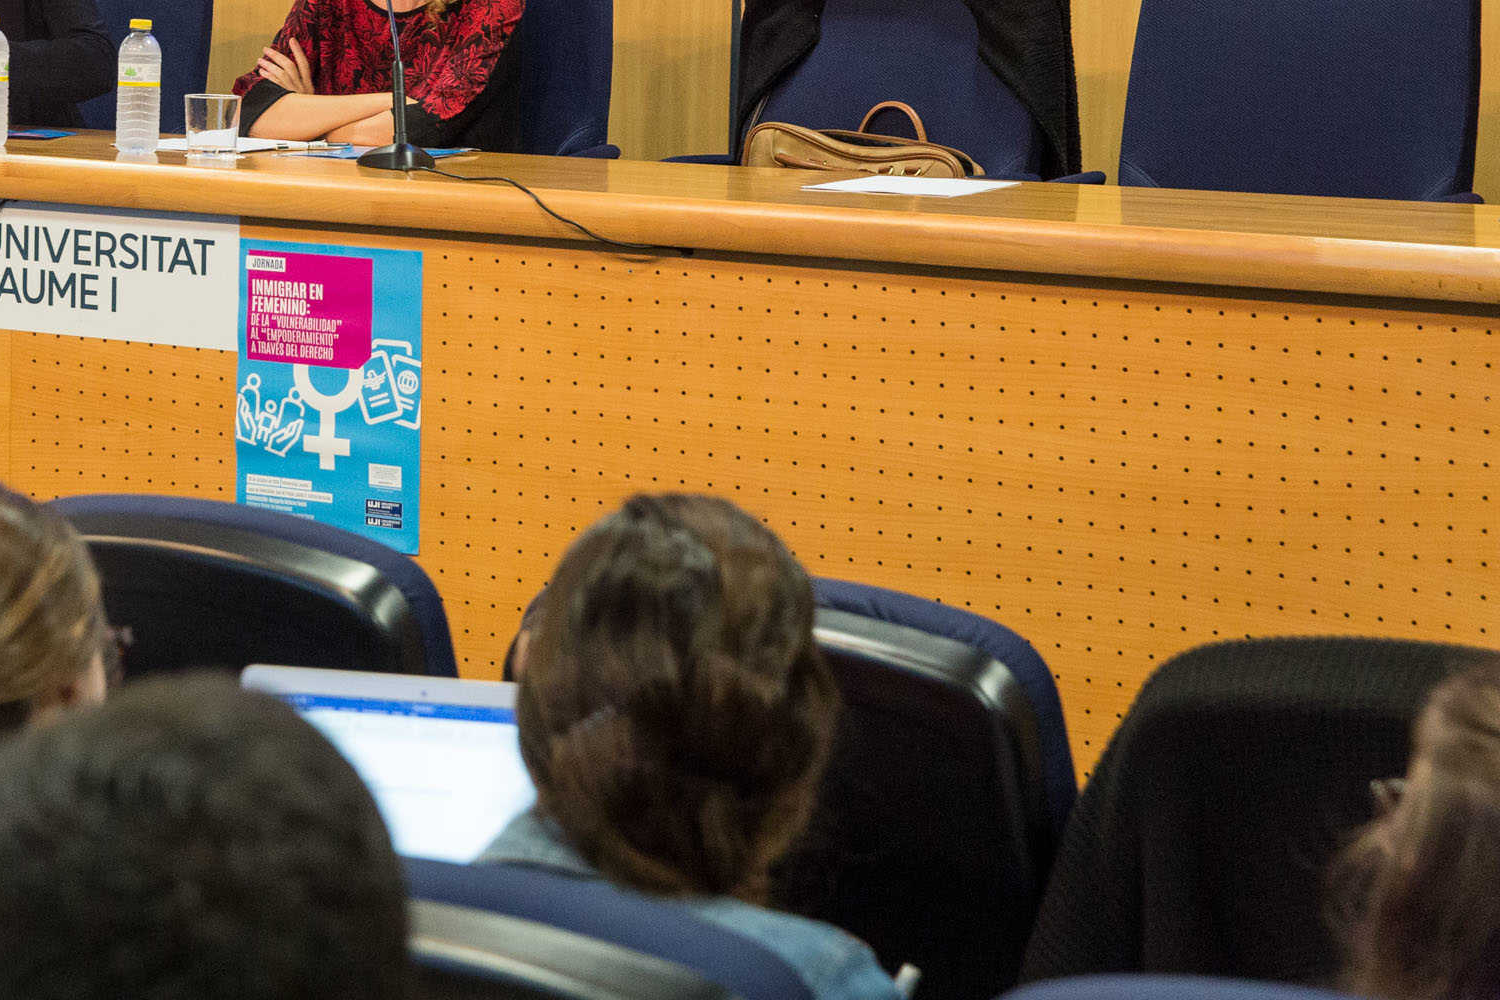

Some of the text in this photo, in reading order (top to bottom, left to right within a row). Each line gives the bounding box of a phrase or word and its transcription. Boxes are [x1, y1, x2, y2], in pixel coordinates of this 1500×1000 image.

[252, 258, 284, 270] JORNADA
[111, 277, 117, 312] I
[252, 278, 323, 300] INMIGRAR EN
[252, 295, 310, 316] FEMENINO:
[251, 313, 342, 333] DE LA “VULNERABILIDAD”
[251, 327, 339, 347] AL “EMPODERAMIENTO”
[251, 340, 333, 360] A TRAVÉS DEL DERECHO
